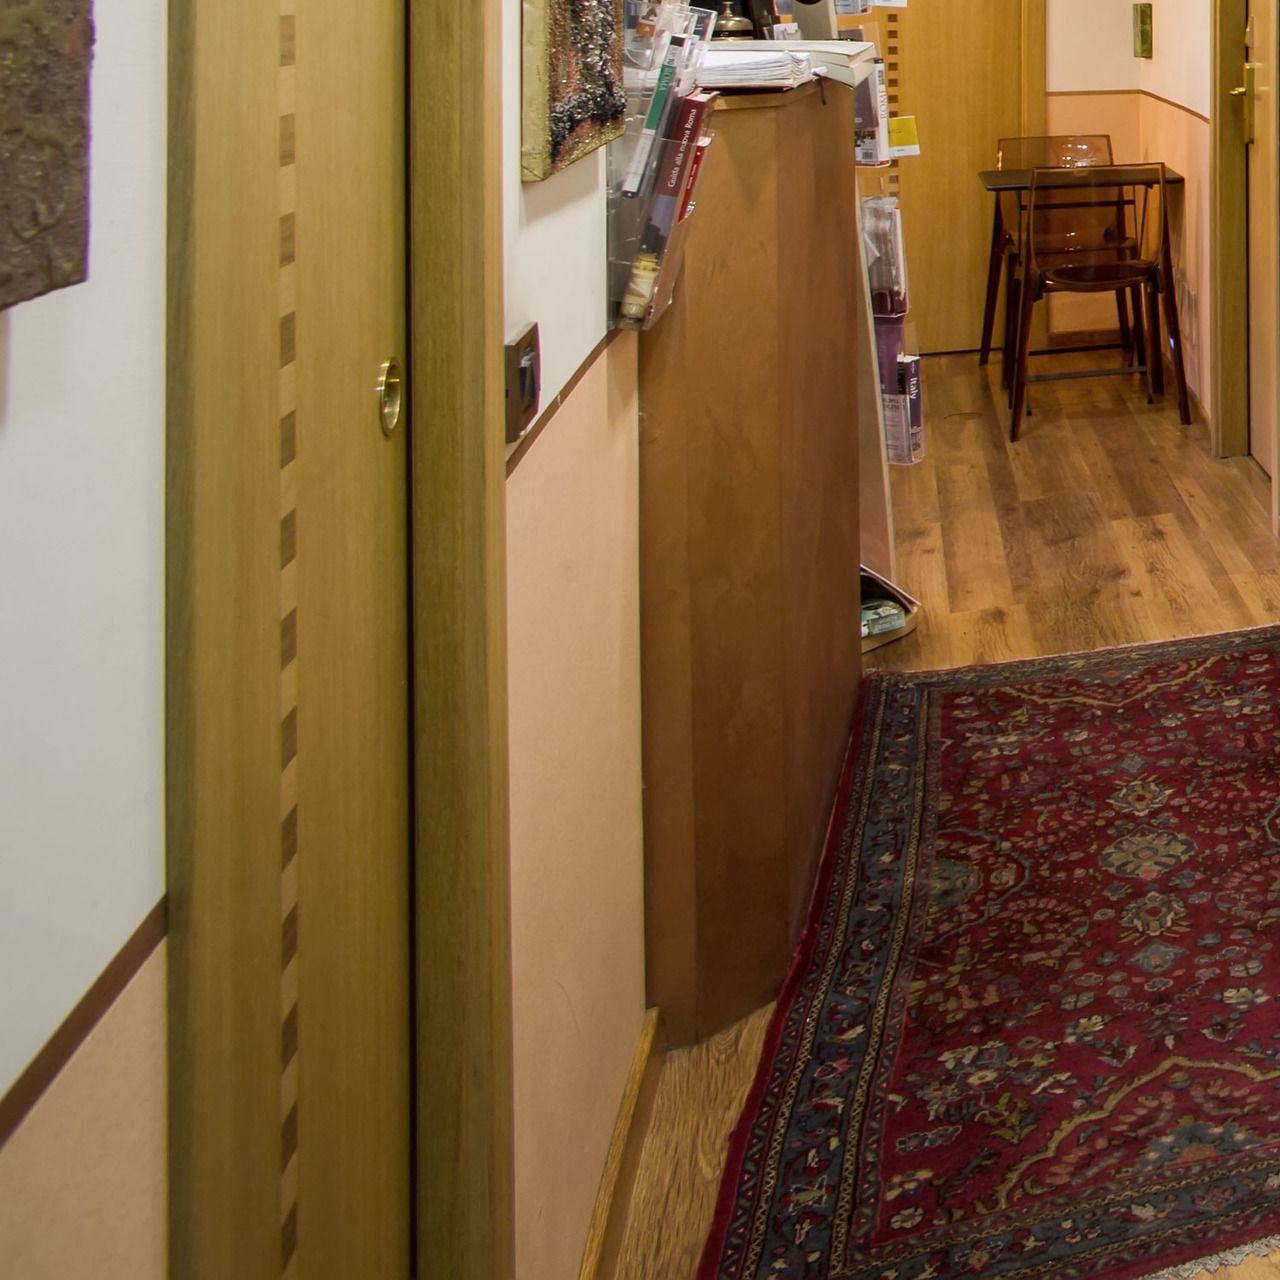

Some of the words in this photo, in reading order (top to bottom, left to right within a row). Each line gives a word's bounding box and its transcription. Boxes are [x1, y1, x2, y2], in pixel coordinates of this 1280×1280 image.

[668, 169, 682, 188] Guida
[676, 151, 686, 168] alla
[686, 108, 697, 129] Roma
[910, 377, 918, 399] Italy
